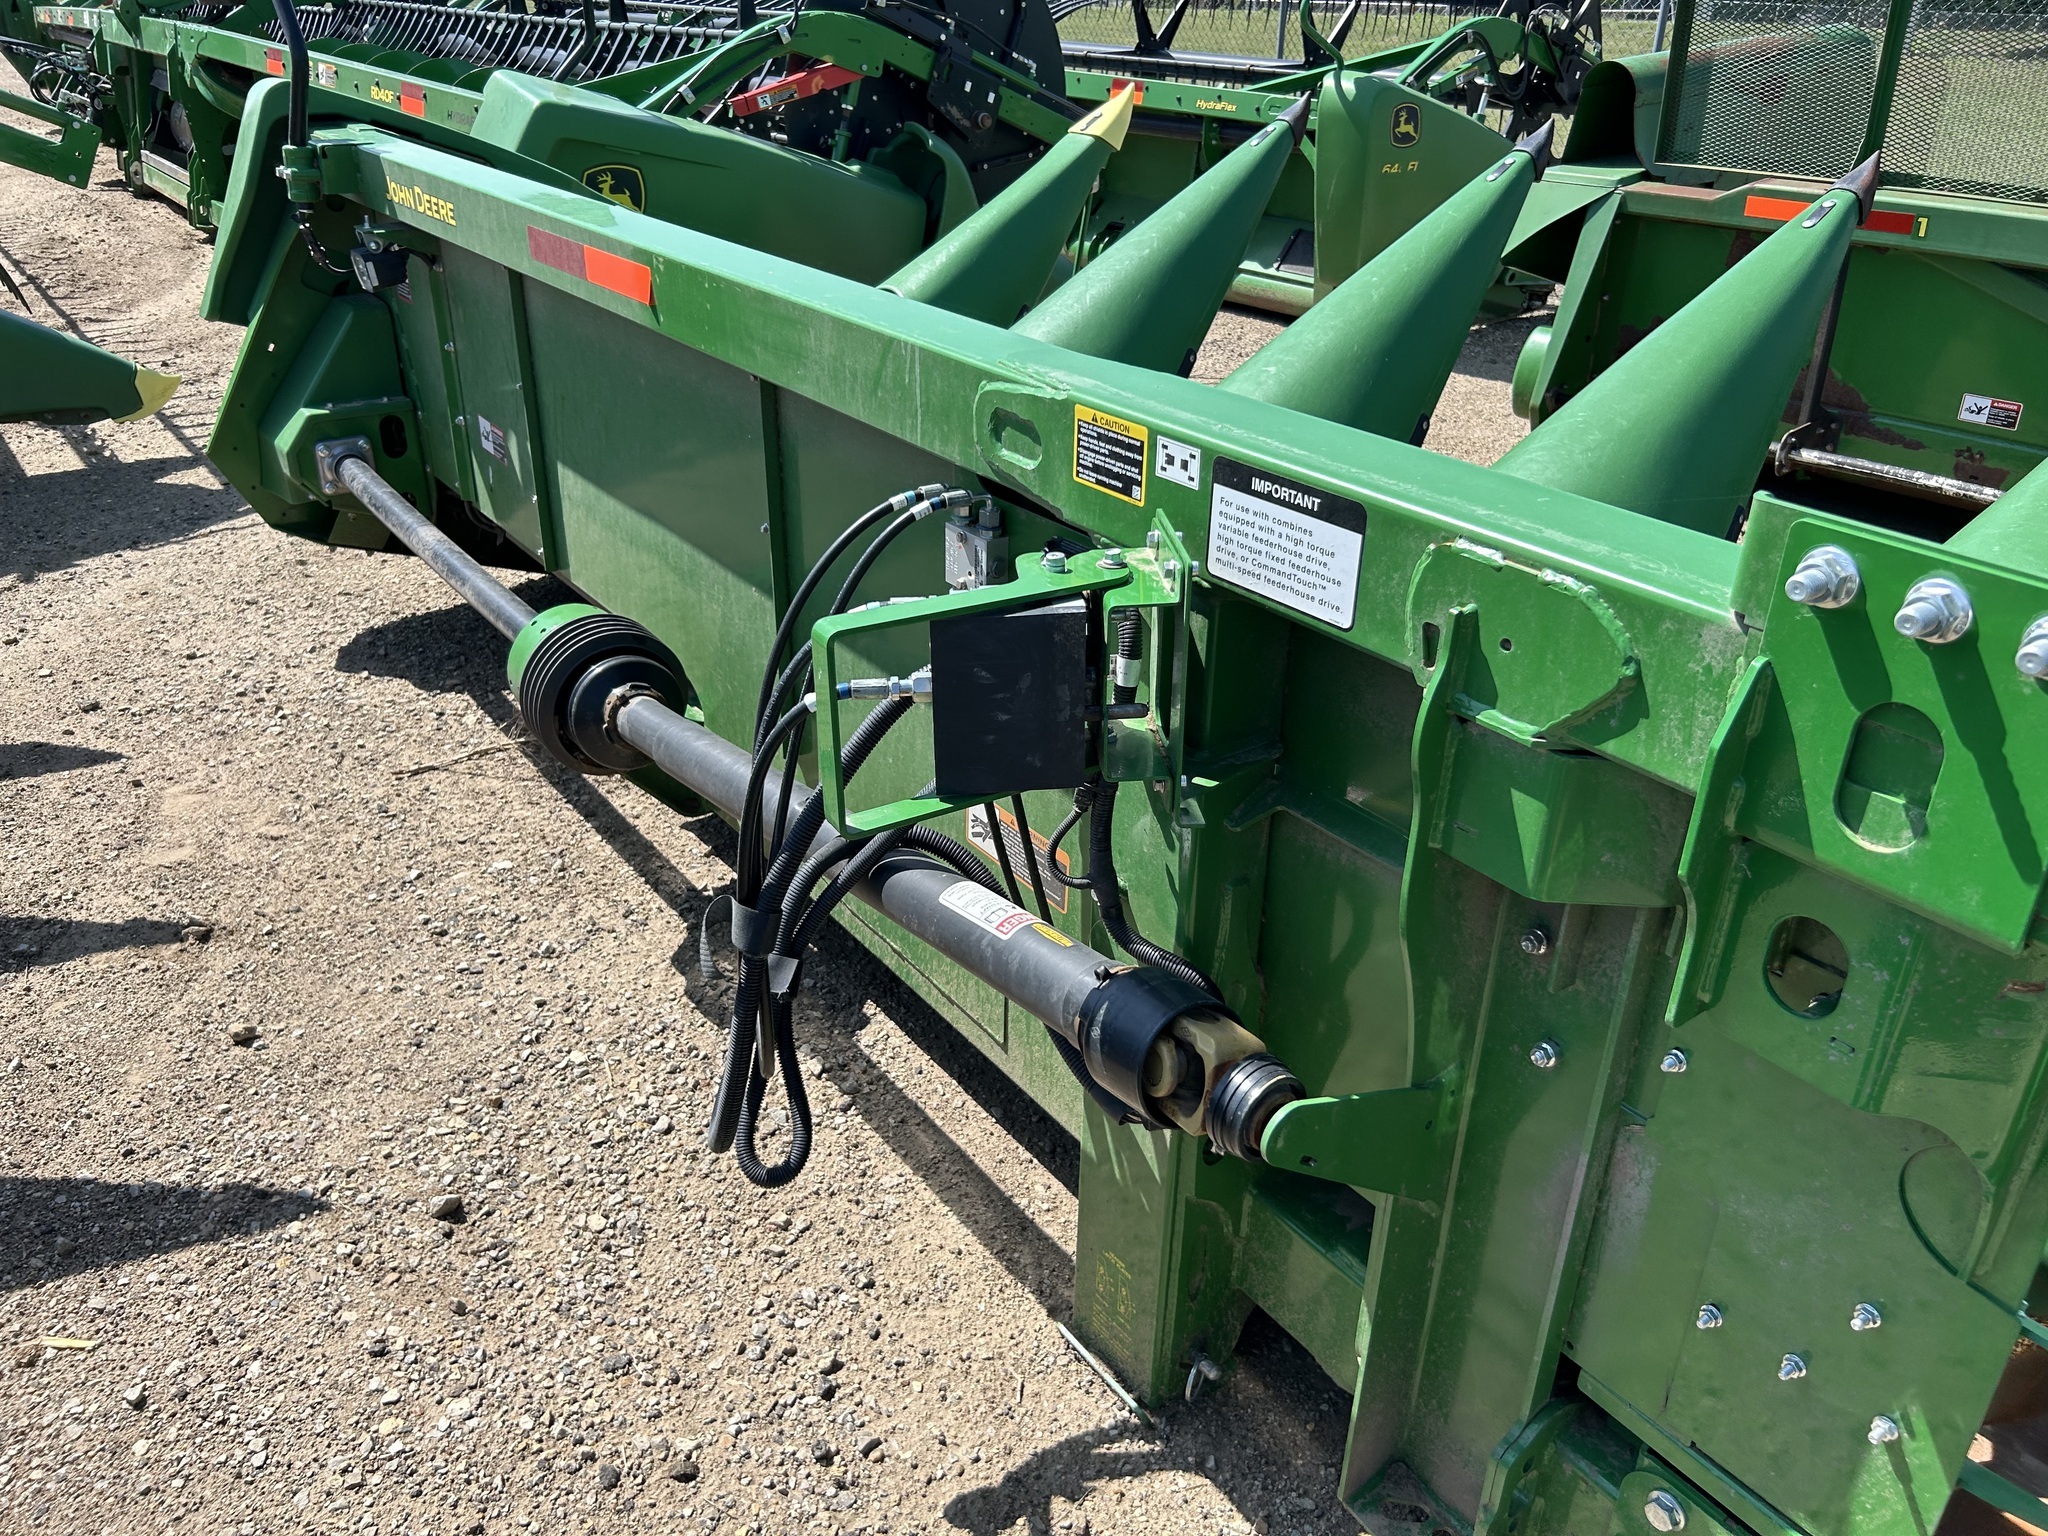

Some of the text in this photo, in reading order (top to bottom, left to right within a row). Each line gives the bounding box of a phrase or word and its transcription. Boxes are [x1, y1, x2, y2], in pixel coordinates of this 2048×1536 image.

[1196, 99, 1237, 112] HydraFlex
[386, 176, 457, 227] JOHN DEERE
[1917, 217, 1929, 237] 1
[1100, 417, 1130, 435] CAUTION
[1220, 497, 1313, 538] For use with combines
[1251, 477, 1322, 512] IMPORTANT
[1218, 522, 1331, 571] variable feederhouse drive,
[1219, 510, 1256, 529] equipped
[1258, 524, 1275, 536] with
[1286, 534, 1304, 548] high
[1307, 542, 1336, 559] torque
[1216, 545, 1327, 591] drive, or CommandTouch™
[1217, 532, 1342, 587] high torque fixed feederhouse
[1215, 557, 1343, 614] multi-speed feederhouse drive.
